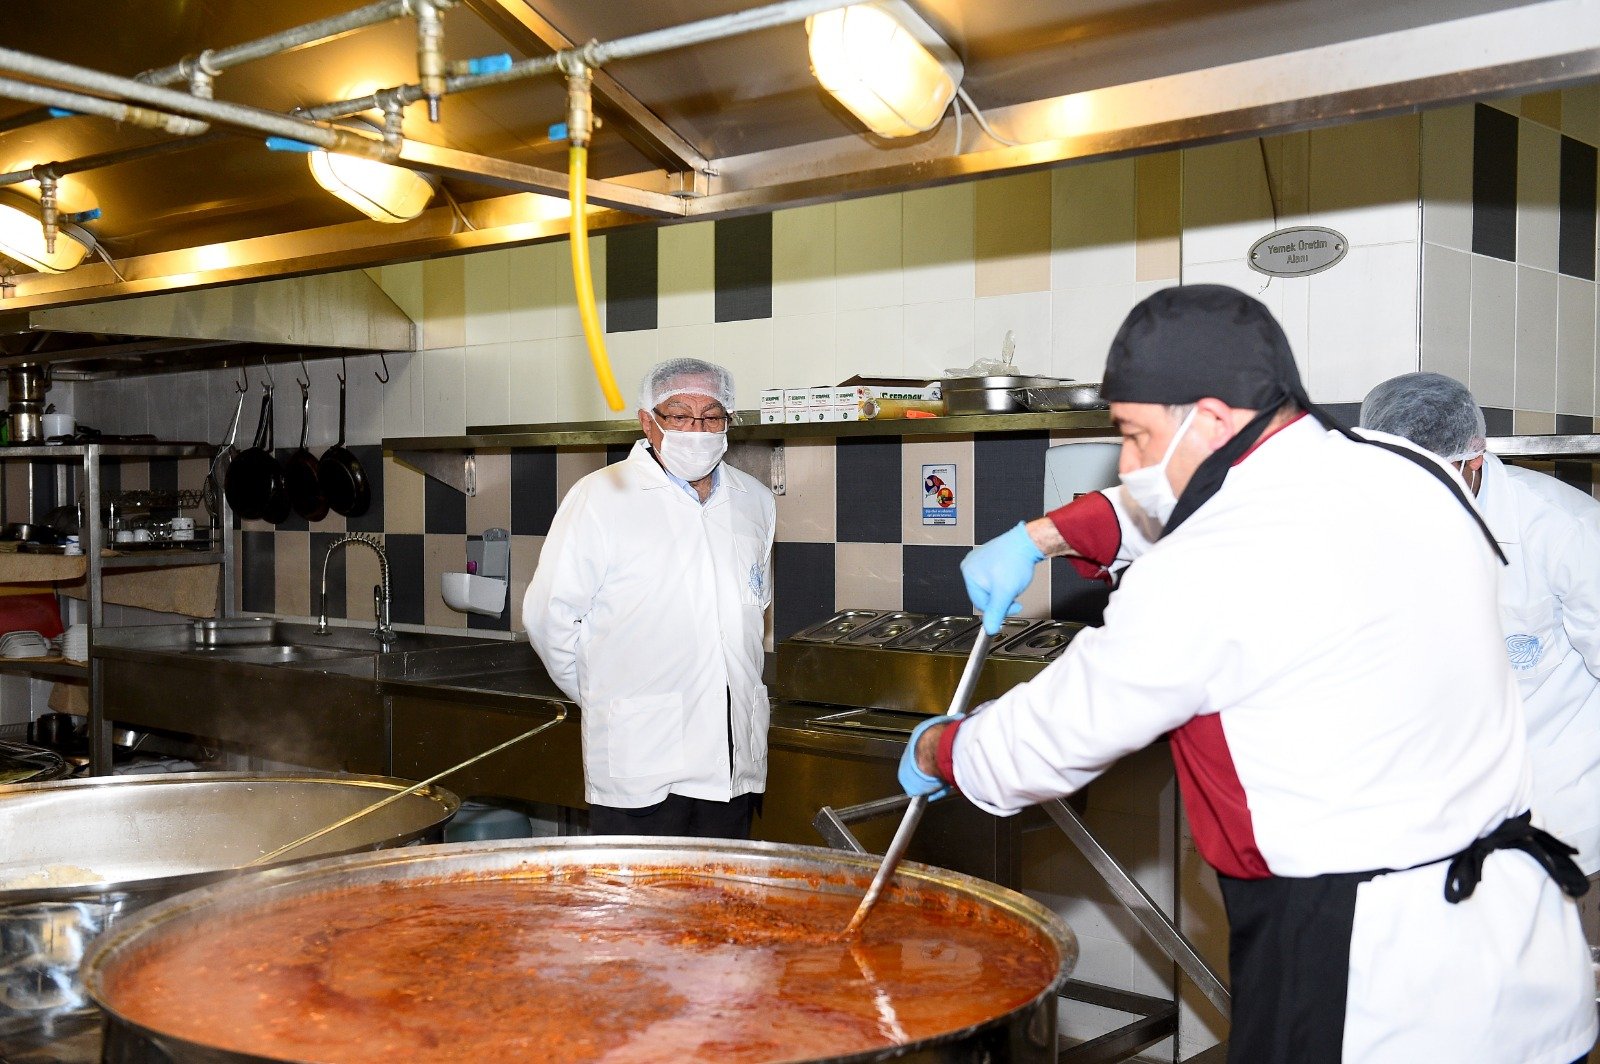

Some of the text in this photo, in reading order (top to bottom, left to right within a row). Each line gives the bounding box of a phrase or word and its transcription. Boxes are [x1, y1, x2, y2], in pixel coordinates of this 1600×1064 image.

[1267, 240, 1328, 254] Yemek Üretim
[1286, 254, 1309, 264] Alanı
